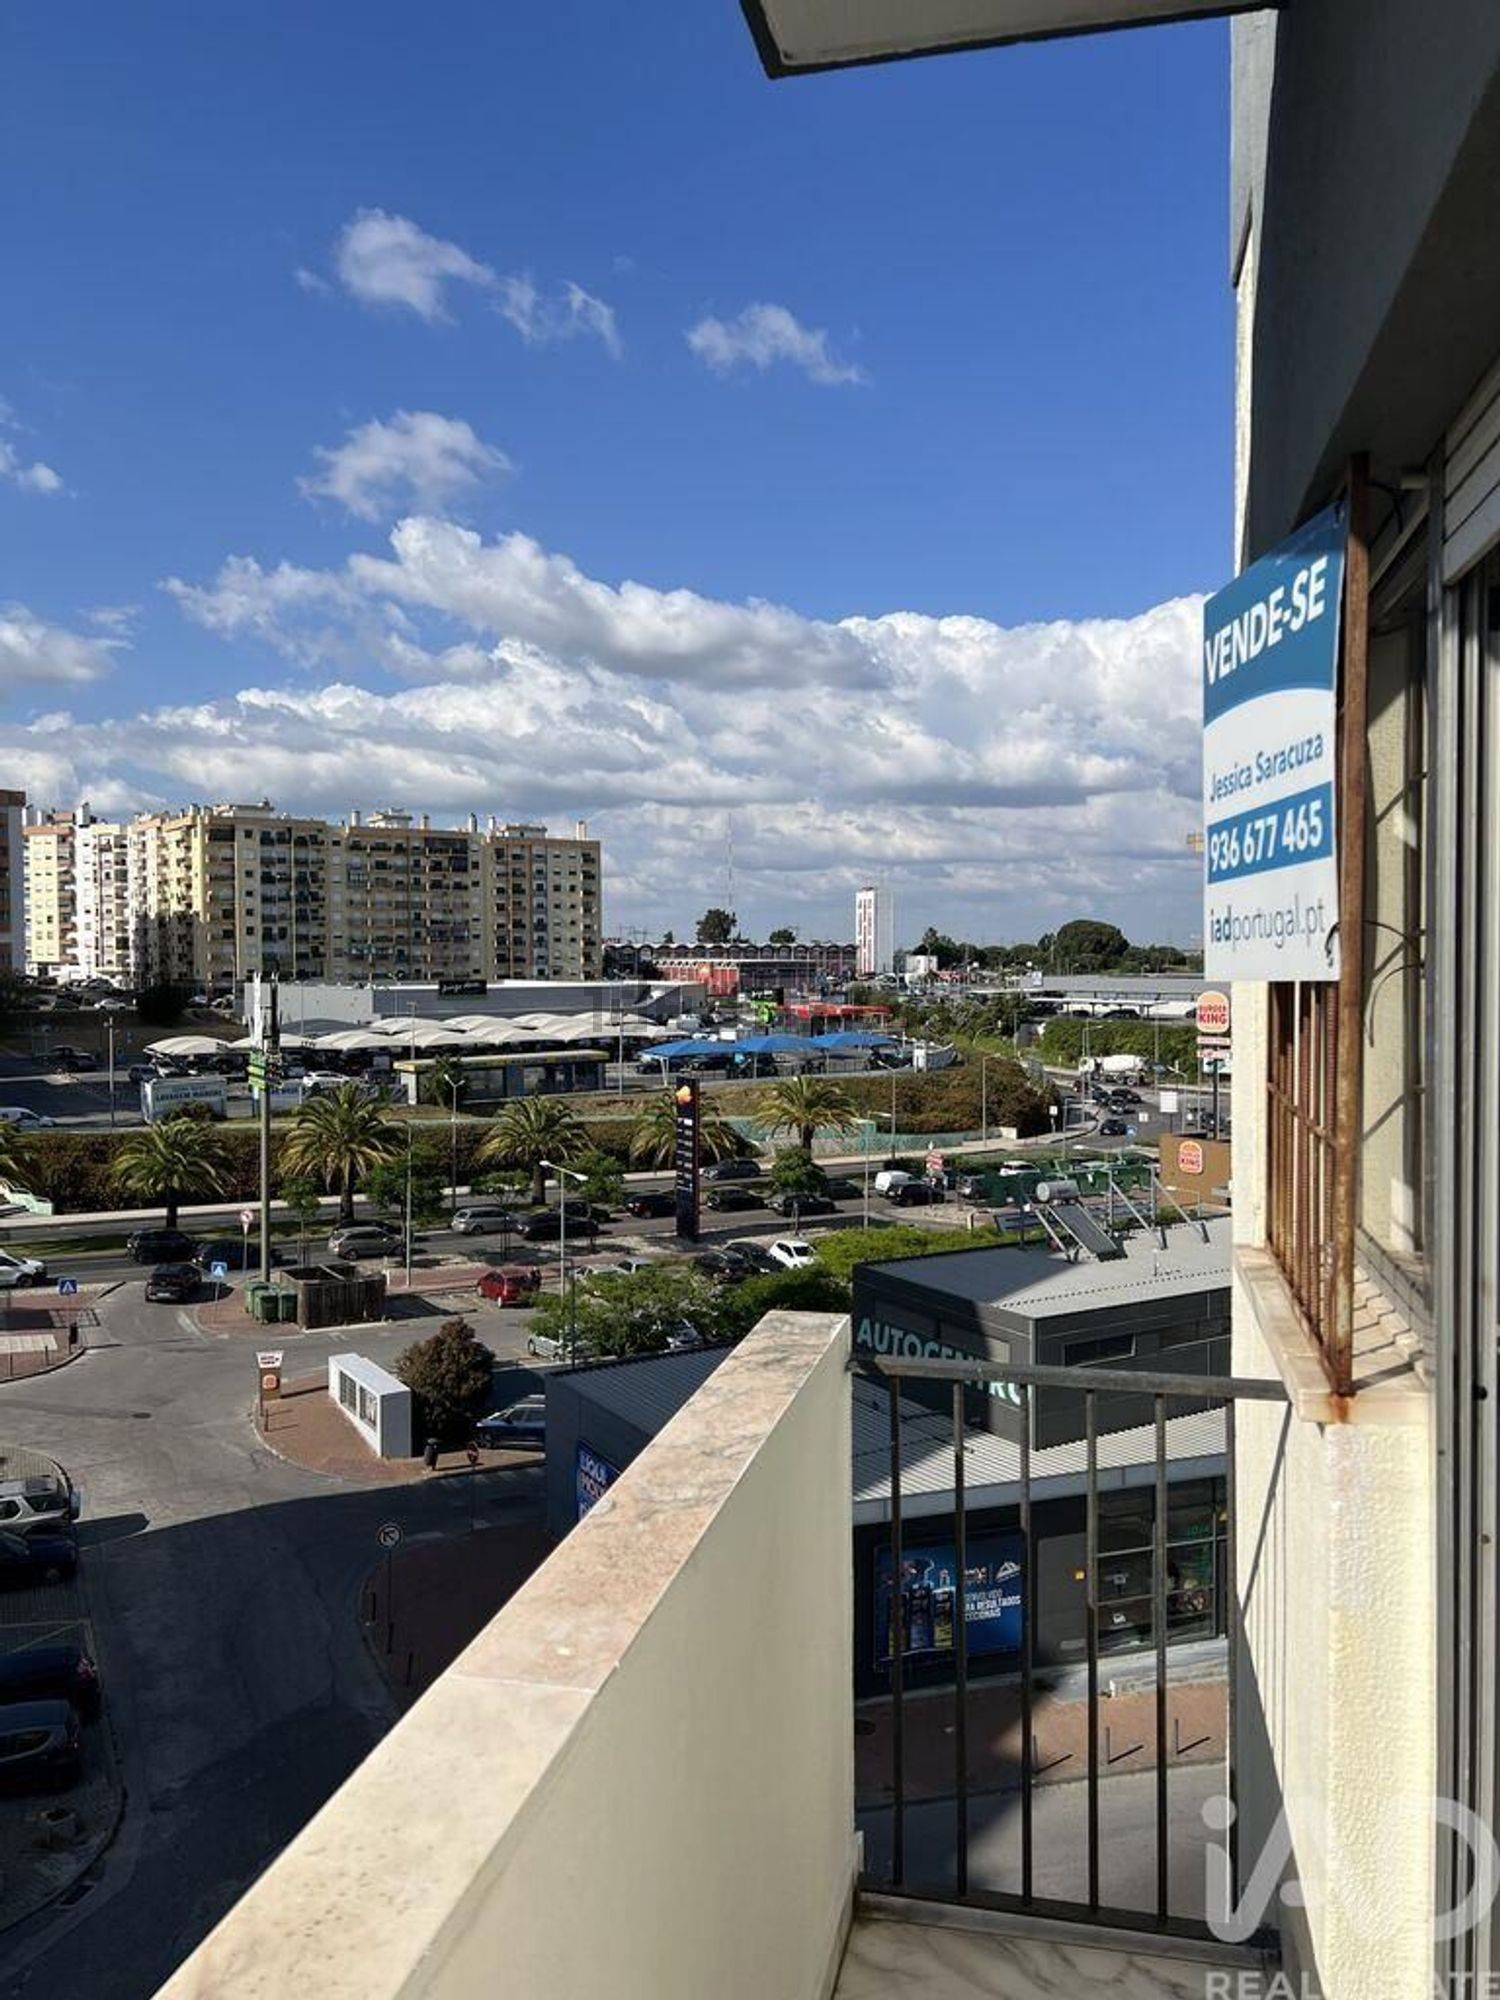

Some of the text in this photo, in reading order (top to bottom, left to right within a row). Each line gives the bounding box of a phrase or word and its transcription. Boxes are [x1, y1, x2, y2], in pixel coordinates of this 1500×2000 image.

[1205, 556, 1329, 686] VENDE-SE
[1210, 734, 1324, 802] Jessica Saracuza
[1210, 800, 1323, 873] 936 677 465
[1210, 893, 1326, 951] iadportugal.pt
[1199, 1013, 1228, 1025] KING
